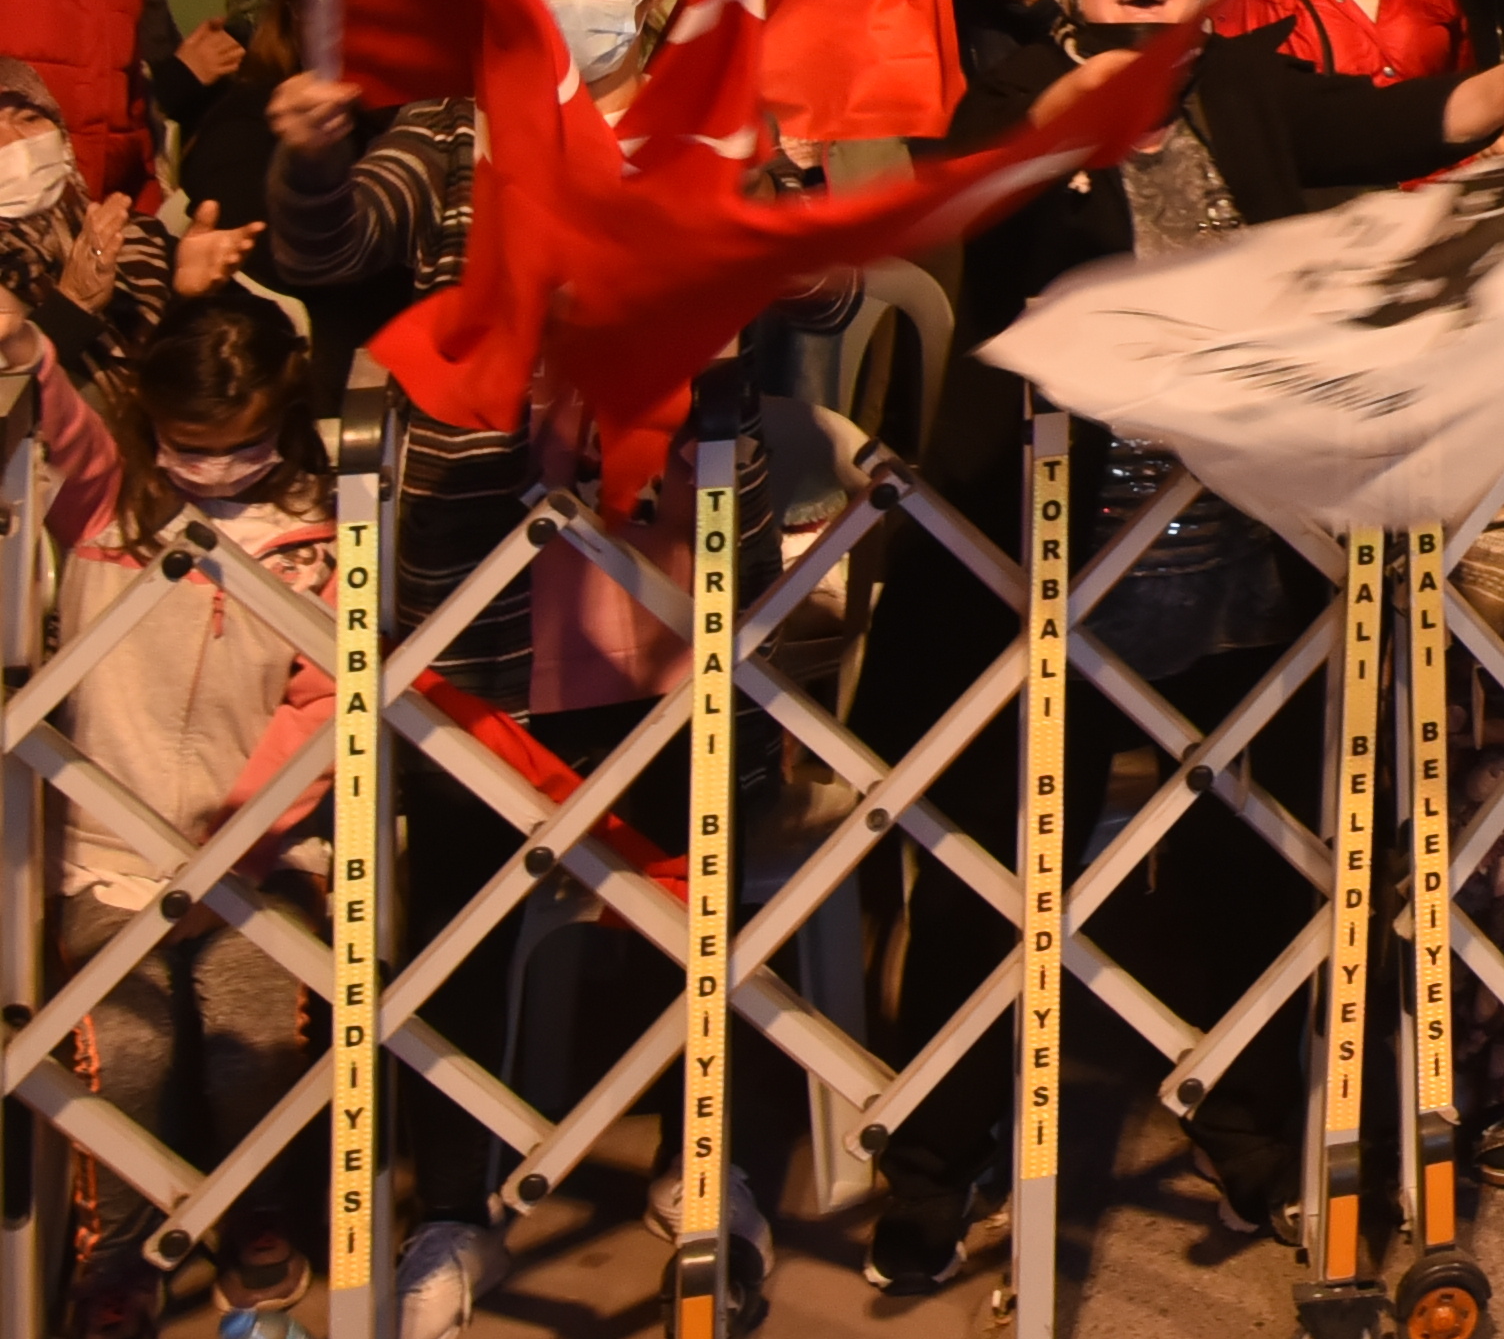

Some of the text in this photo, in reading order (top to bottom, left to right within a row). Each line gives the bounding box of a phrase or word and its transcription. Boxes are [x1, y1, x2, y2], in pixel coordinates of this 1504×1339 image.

[343, 524, 371, 1254] TORBALI BELEDİYESİ
[697, 491, 726, 1198] TORBALI BELEDİYESİ
[1034, 461, 1061, 1144] TORBALI BELEDİYESİ
[1340, 545, 1374, 1098] BALI BELEDİYESİ
[1422, 722, 1443, 1076] BELEDİYESİ
